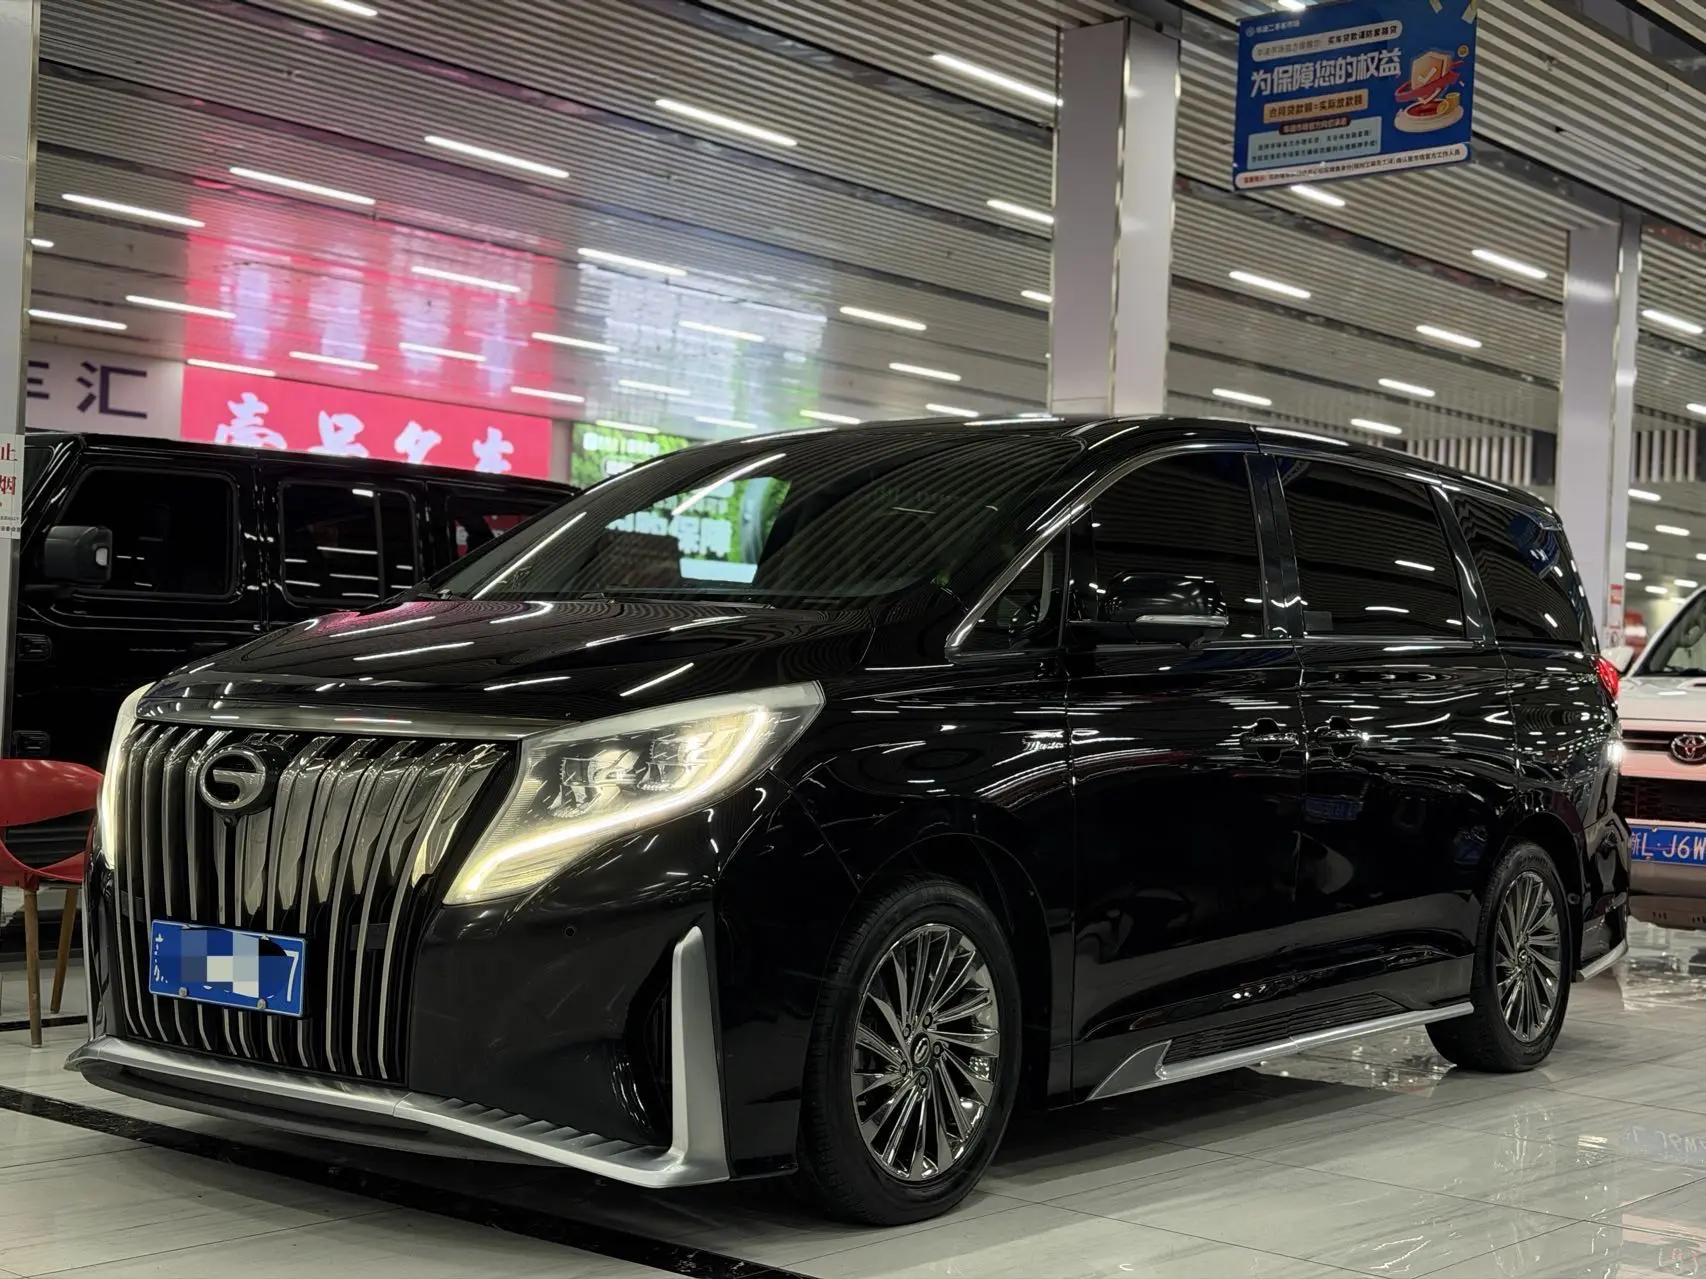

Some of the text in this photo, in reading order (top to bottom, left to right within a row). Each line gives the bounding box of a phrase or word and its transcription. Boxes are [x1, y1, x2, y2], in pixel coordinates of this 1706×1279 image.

[1251, 48, 1401, 97] 为保障您的权益
